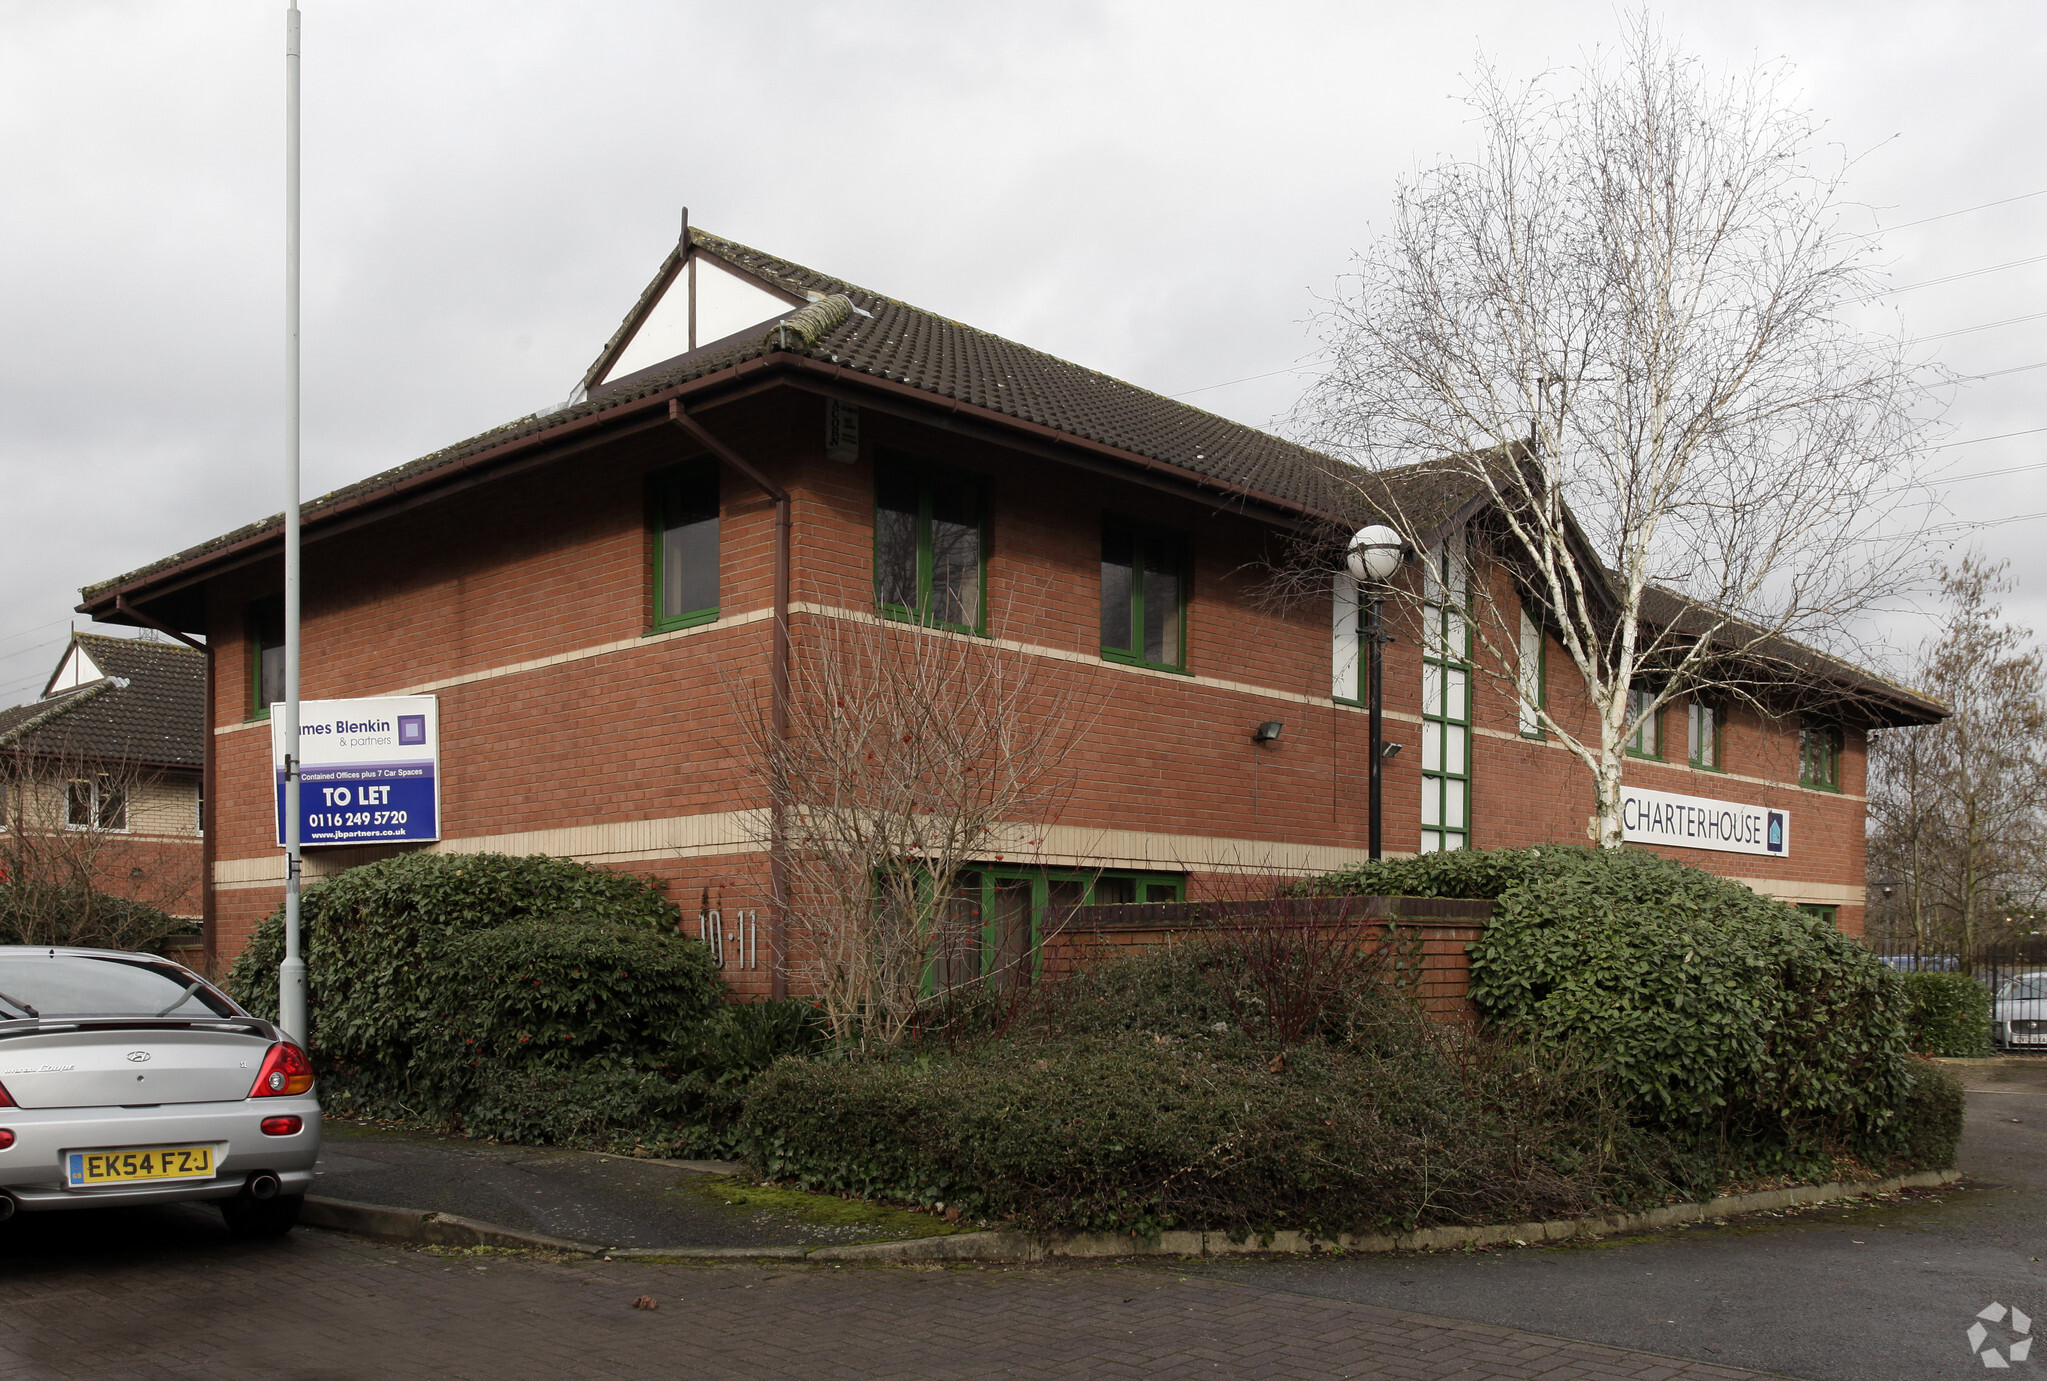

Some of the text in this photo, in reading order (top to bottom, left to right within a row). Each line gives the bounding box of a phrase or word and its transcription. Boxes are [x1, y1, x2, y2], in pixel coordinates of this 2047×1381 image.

[298, 719, 390, 736] mes Blenkin
[339, 735, 391, 748] & partners
[301, 767, 423, 781] Contained Offices plus 7 Car Spaces
[322, 785, 391, 807] TO LET
[309, 810, 408, 828] 0116 249 5720
[1623, 797, 1761, 845] CHARTERHOUSE
[311, 827, 406, 840] www.jbpartners.co.uk
[88, 1150, 209, 1178] EK54 FZJ
